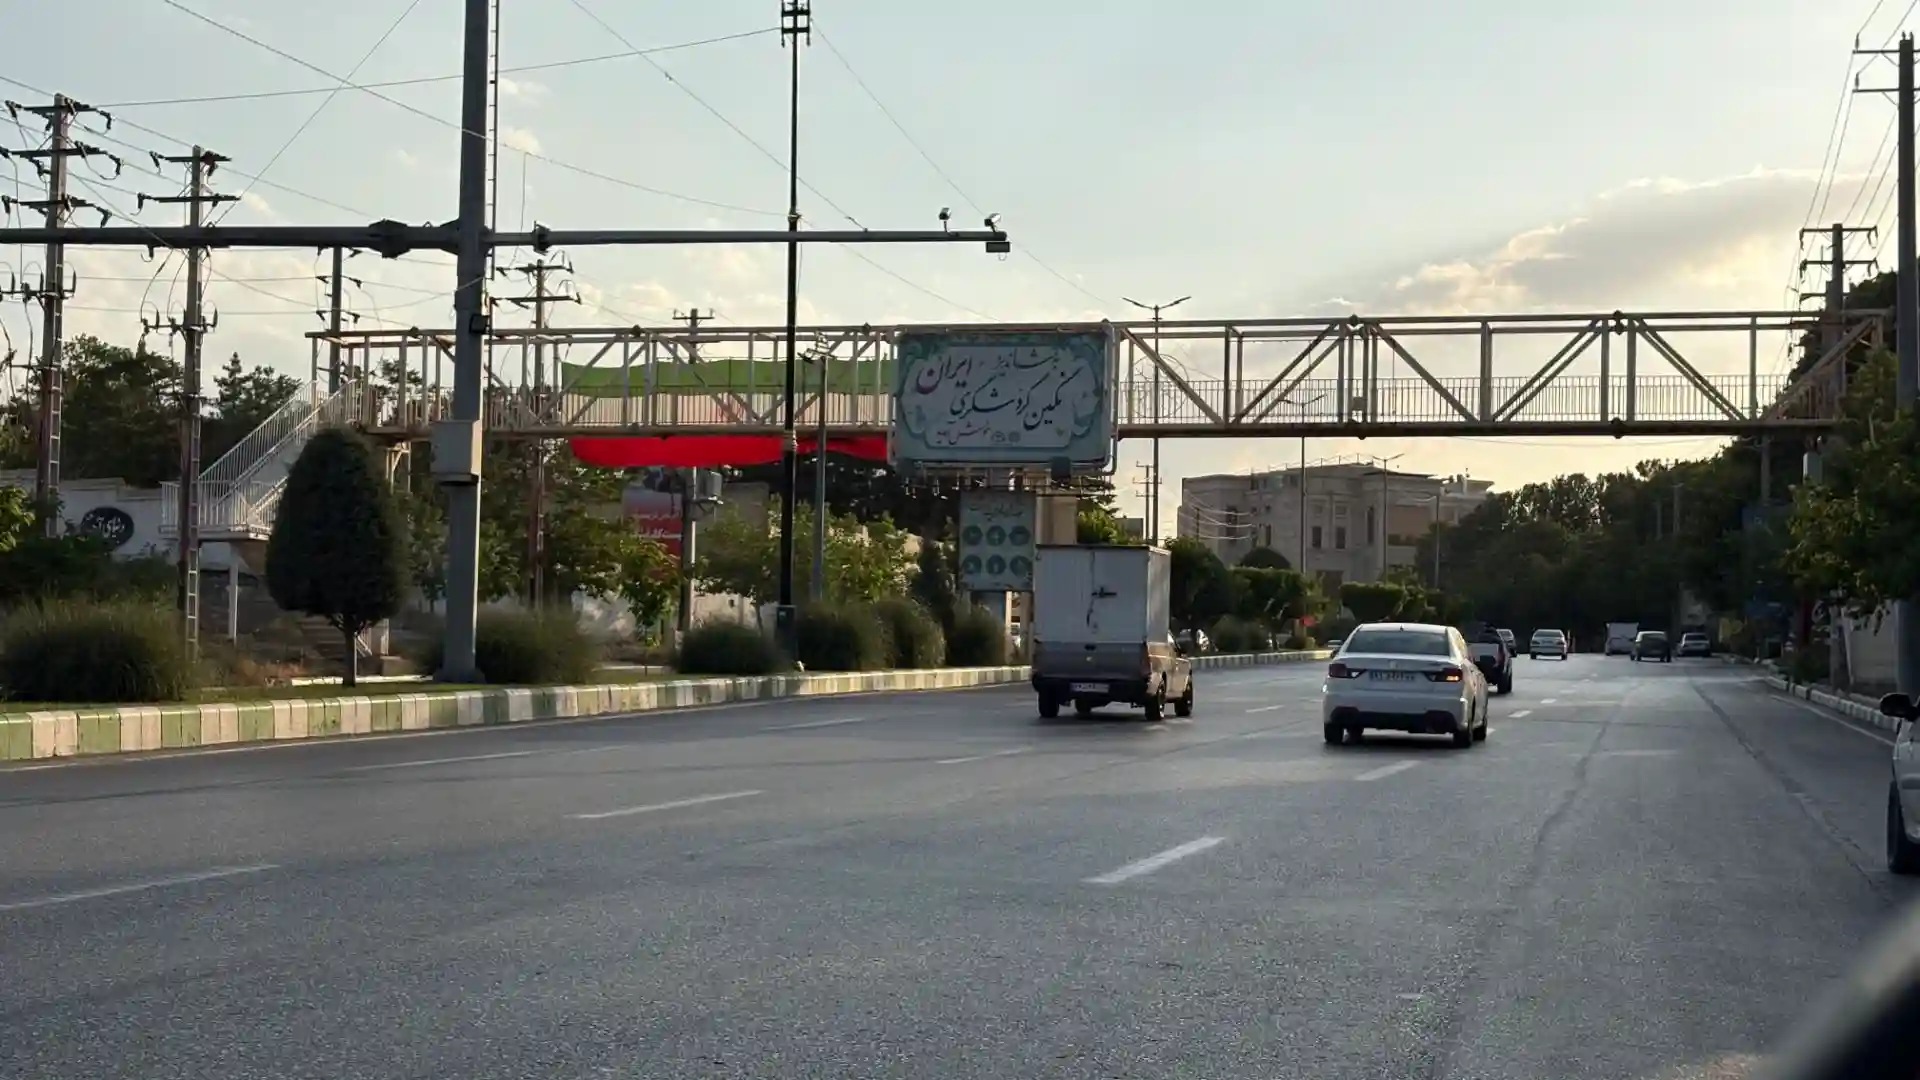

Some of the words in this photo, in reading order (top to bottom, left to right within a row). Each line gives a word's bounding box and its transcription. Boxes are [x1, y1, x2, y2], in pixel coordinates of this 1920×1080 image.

[916, 353, 972, 394] ایران
[950, 371, 1050, 419] گردشگری
[1023, 366, 1084, 431] نگین
